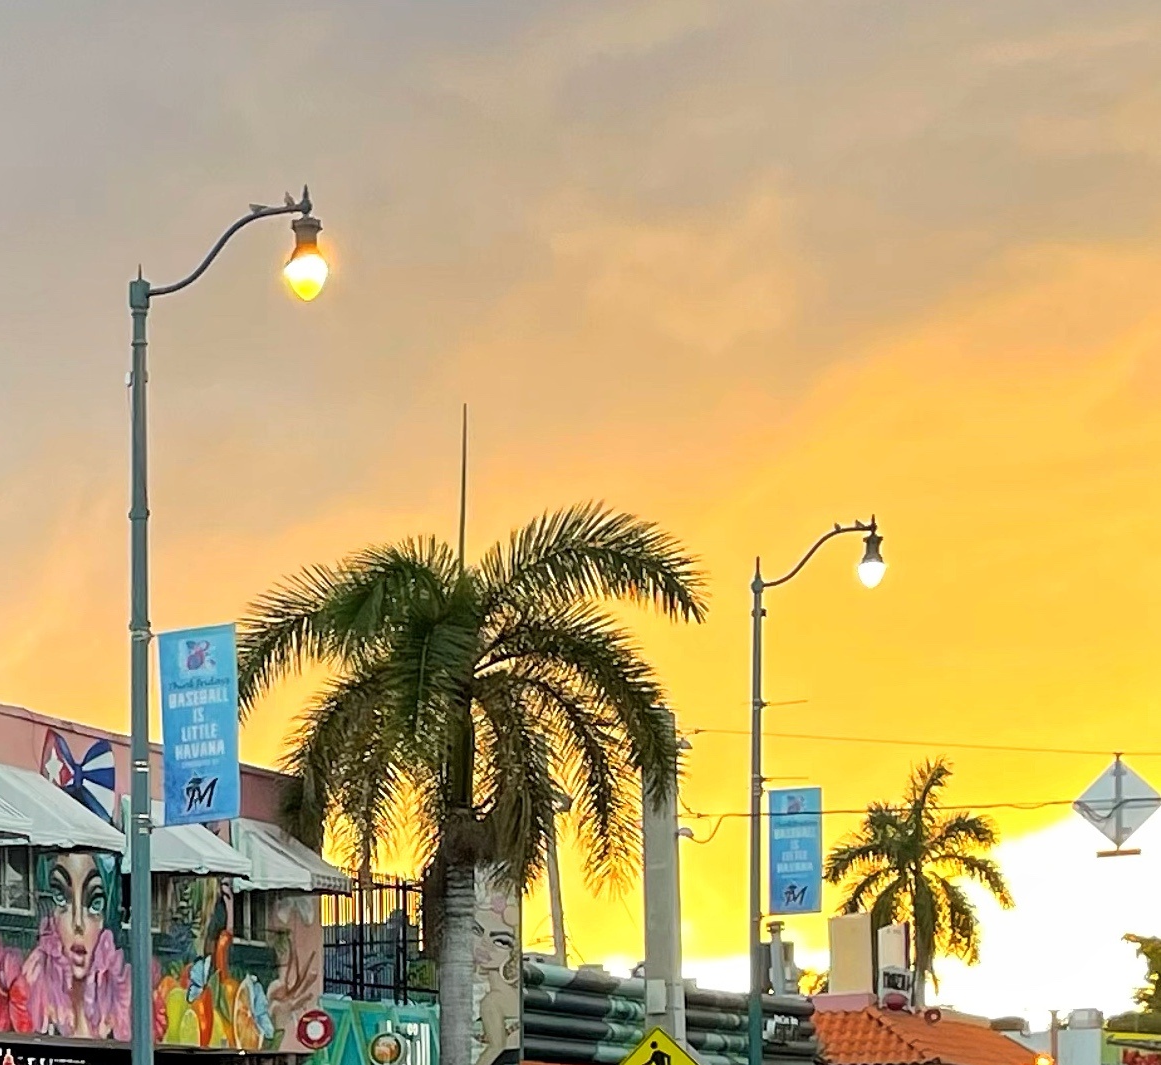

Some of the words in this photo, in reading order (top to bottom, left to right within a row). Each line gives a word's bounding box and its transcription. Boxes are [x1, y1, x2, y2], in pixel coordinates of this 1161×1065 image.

[168, 687, 229, 709] BASEBALL
[193, 706, 205, 723] IS
[181, 722, 218, 742] LITTLE
[175, 739, 225, 760] HAVANA
